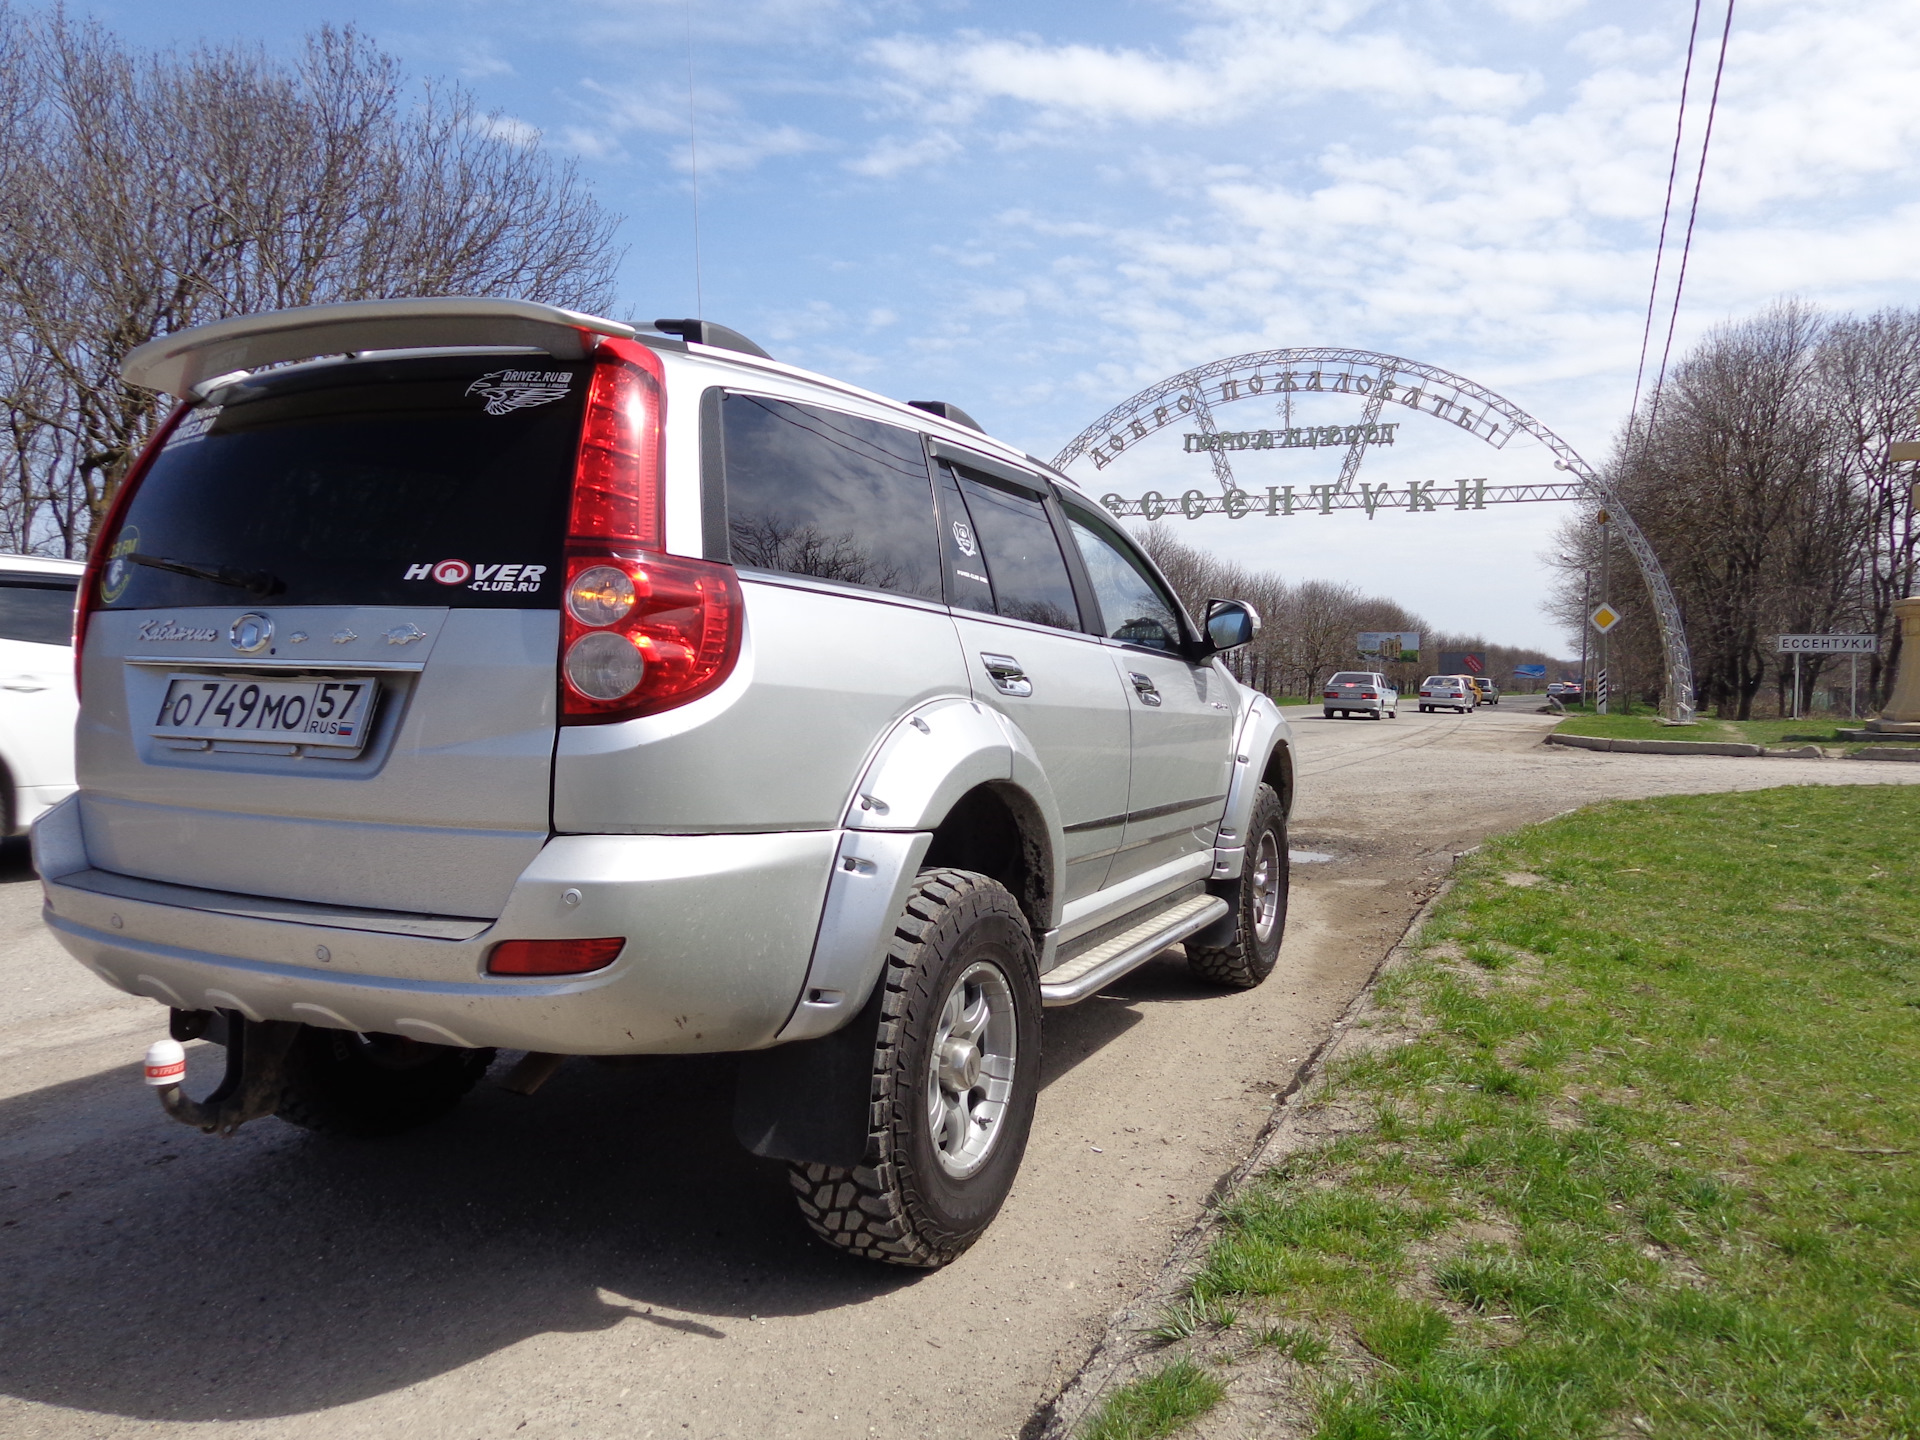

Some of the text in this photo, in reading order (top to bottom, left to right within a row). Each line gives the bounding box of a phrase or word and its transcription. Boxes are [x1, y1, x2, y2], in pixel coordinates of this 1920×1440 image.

[1091, 395, 1192, 471] ДОБРО
[1782, 639, 1872, 649] ЕССЕНТУКИ
[316, 684, 365, 719] 57
[310, 721, 338, 734] RUS
